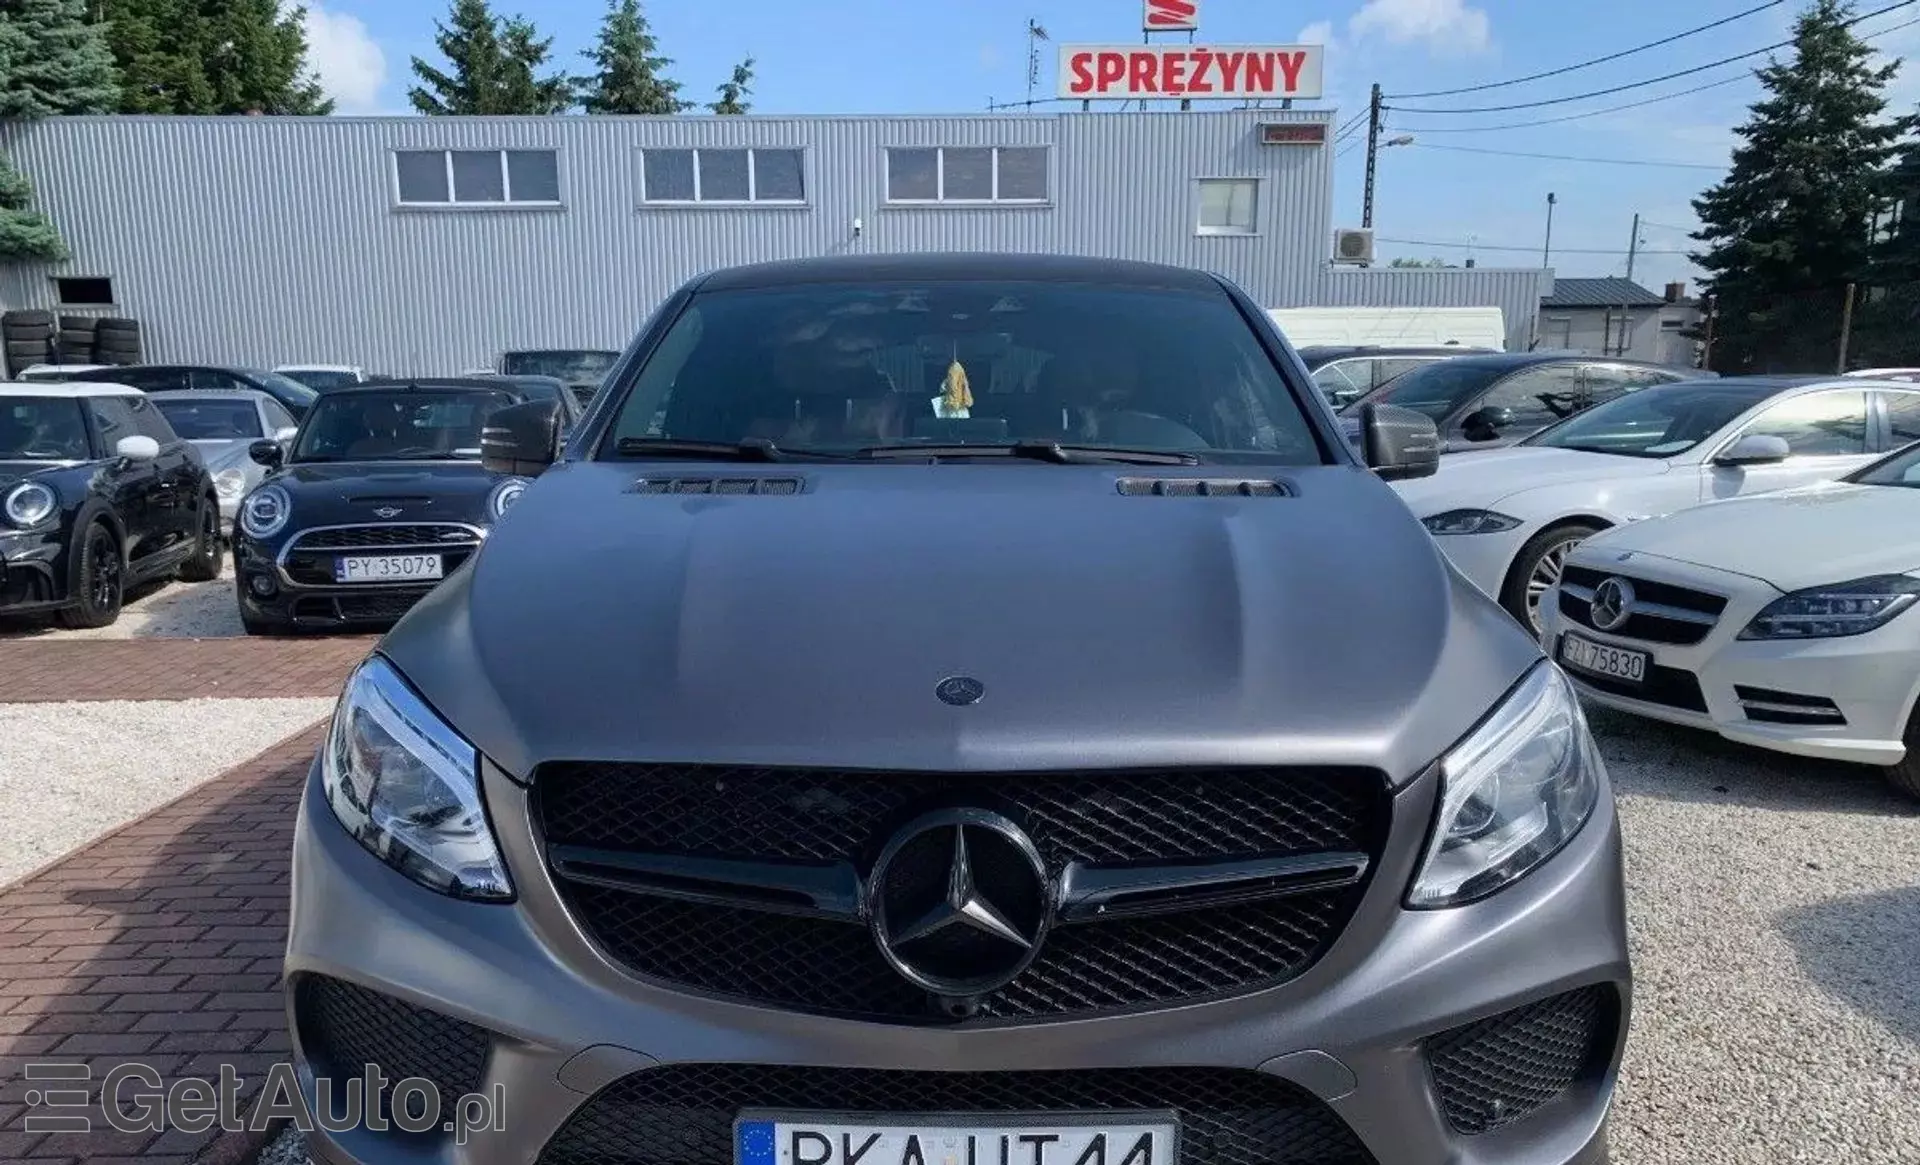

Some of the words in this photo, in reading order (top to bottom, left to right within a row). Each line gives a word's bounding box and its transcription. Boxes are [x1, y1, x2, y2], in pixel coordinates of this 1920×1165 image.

[1070, 47, 1306, 96] SPRĘŻYNY
[347, 559, 371, 576] PY
[379, 556, 436, 575] 35079
[1590, 644, 1643, 678] 75830
